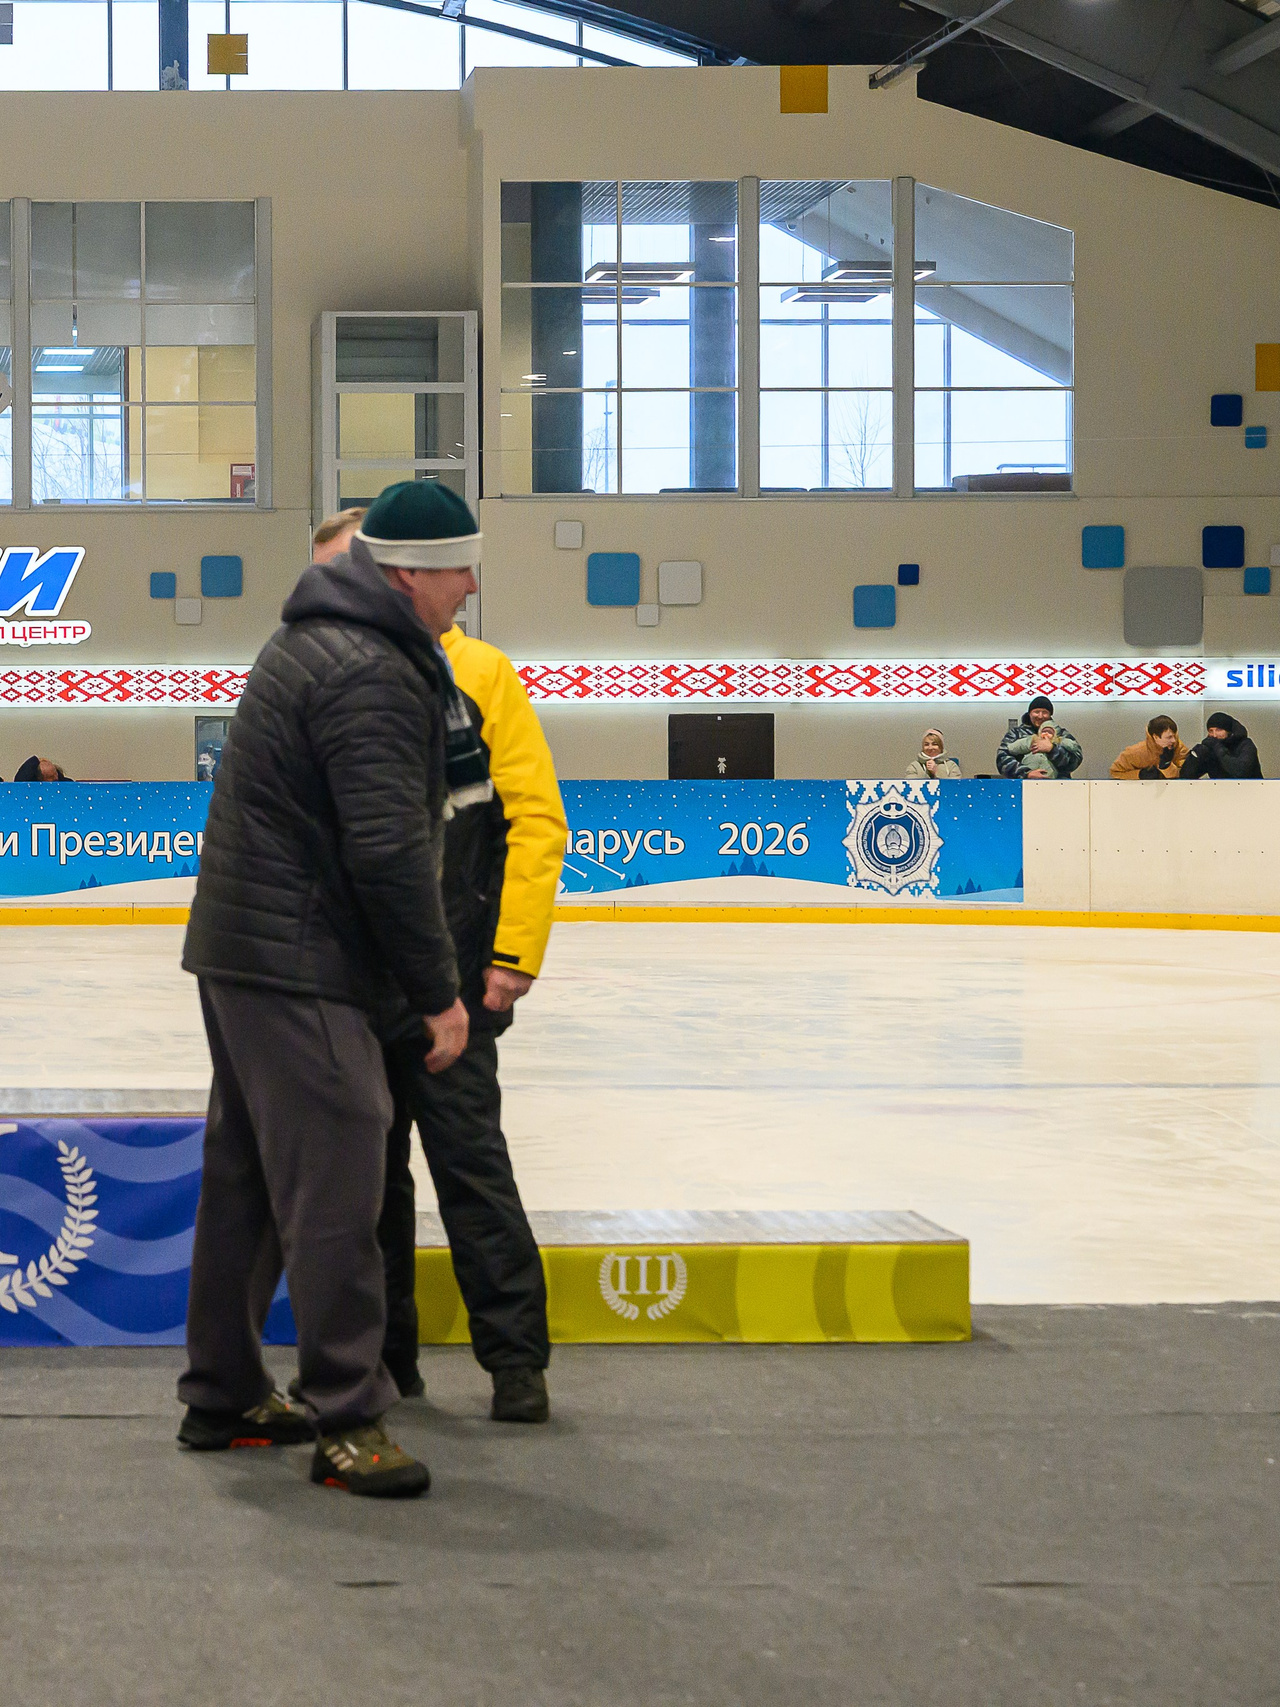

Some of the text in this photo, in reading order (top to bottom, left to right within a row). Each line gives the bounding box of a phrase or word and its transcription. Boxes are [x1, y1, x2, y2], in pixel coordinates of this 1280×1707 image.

[11, 626, 87, 642] ЦЕНТР
[1227, 664, 1280, 688] sili
[30, 823, 205, 865] Президе
[566, 828, 686, 864] арусь
[718, 821, 810, 857] 2026
[615, 1255, 674, 1296] III
